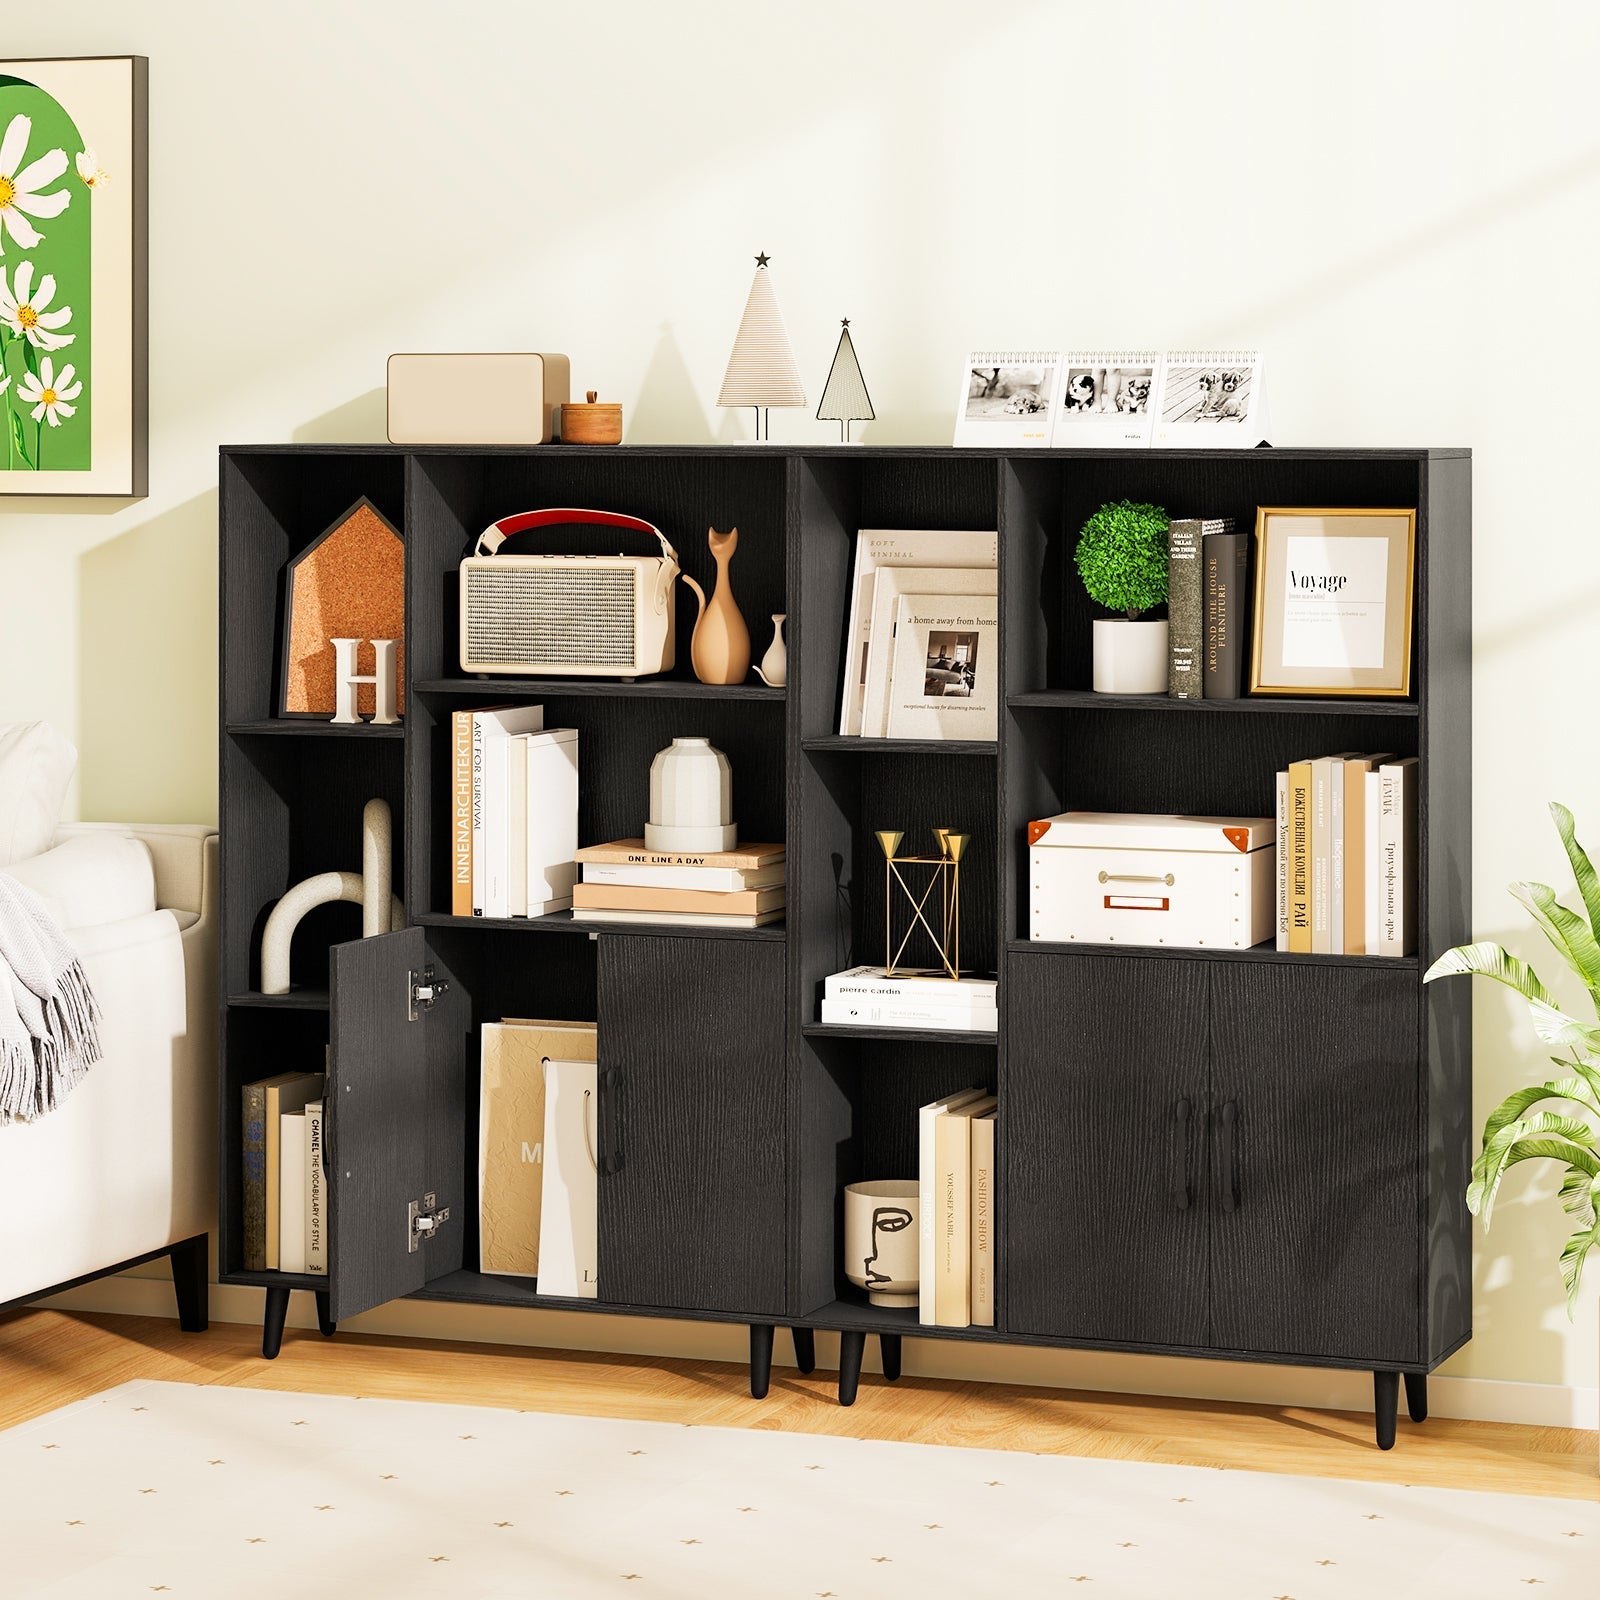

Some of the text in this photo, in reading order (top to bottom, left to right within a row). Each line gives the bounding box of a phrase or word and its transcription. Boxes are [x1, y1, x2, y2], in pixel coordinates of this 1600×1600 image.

[1291, 570, 1348, 592] Voyage
[956, 616, 974, 625] from
[976, 616, 998, 626] home
[457, 712, 470, 884] INNENARCHITEKTUR
[1280, 825, 1288, 861] Уличный
[1294, 788, 1309, 927] БОЖЕСТВЕННАЯ КОМЕДИЯ РАЙ
[1385, 842, 1396, 941] Триумфальная арка
[1280, 917, 1288, 933] Боб
[312, 1218, 319, 1228] OF
[978, 1169, 986, 1253] FASHION SHOW
